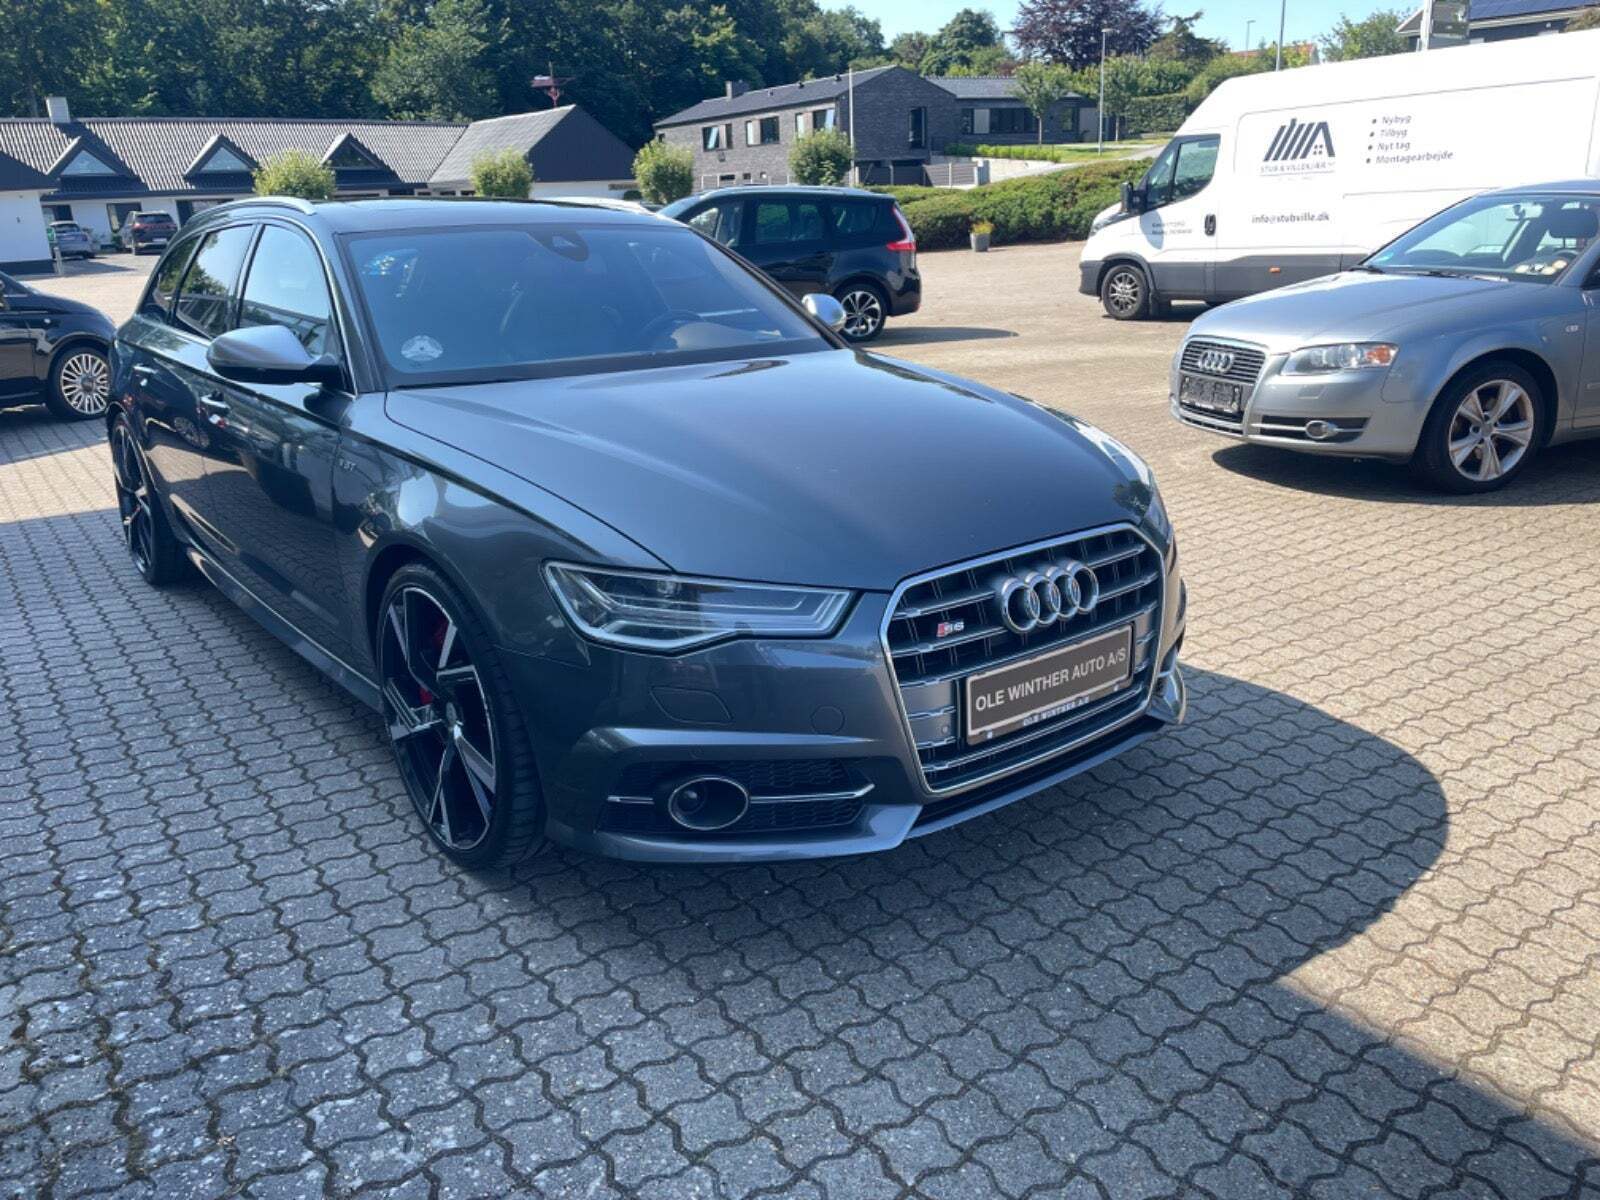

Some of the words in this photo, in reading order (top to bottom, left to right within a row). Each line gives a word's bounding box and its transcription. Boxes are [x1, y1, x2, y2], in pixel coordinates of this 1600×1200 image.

[1382, 115, 1412, 125] Nybyg
[1377, 142, 1393, 152] Nyt
[1396, 142, 1410, 151] tag
[1376, 150, 1454, 164] Montagearbejde
[975, 689, 1005, 711] OLE
[1007, 668, 1070, 701] WINTHER
[1071, 656, 1106, 681] AUTO
[1107, 647, 1127, 667] A/S
